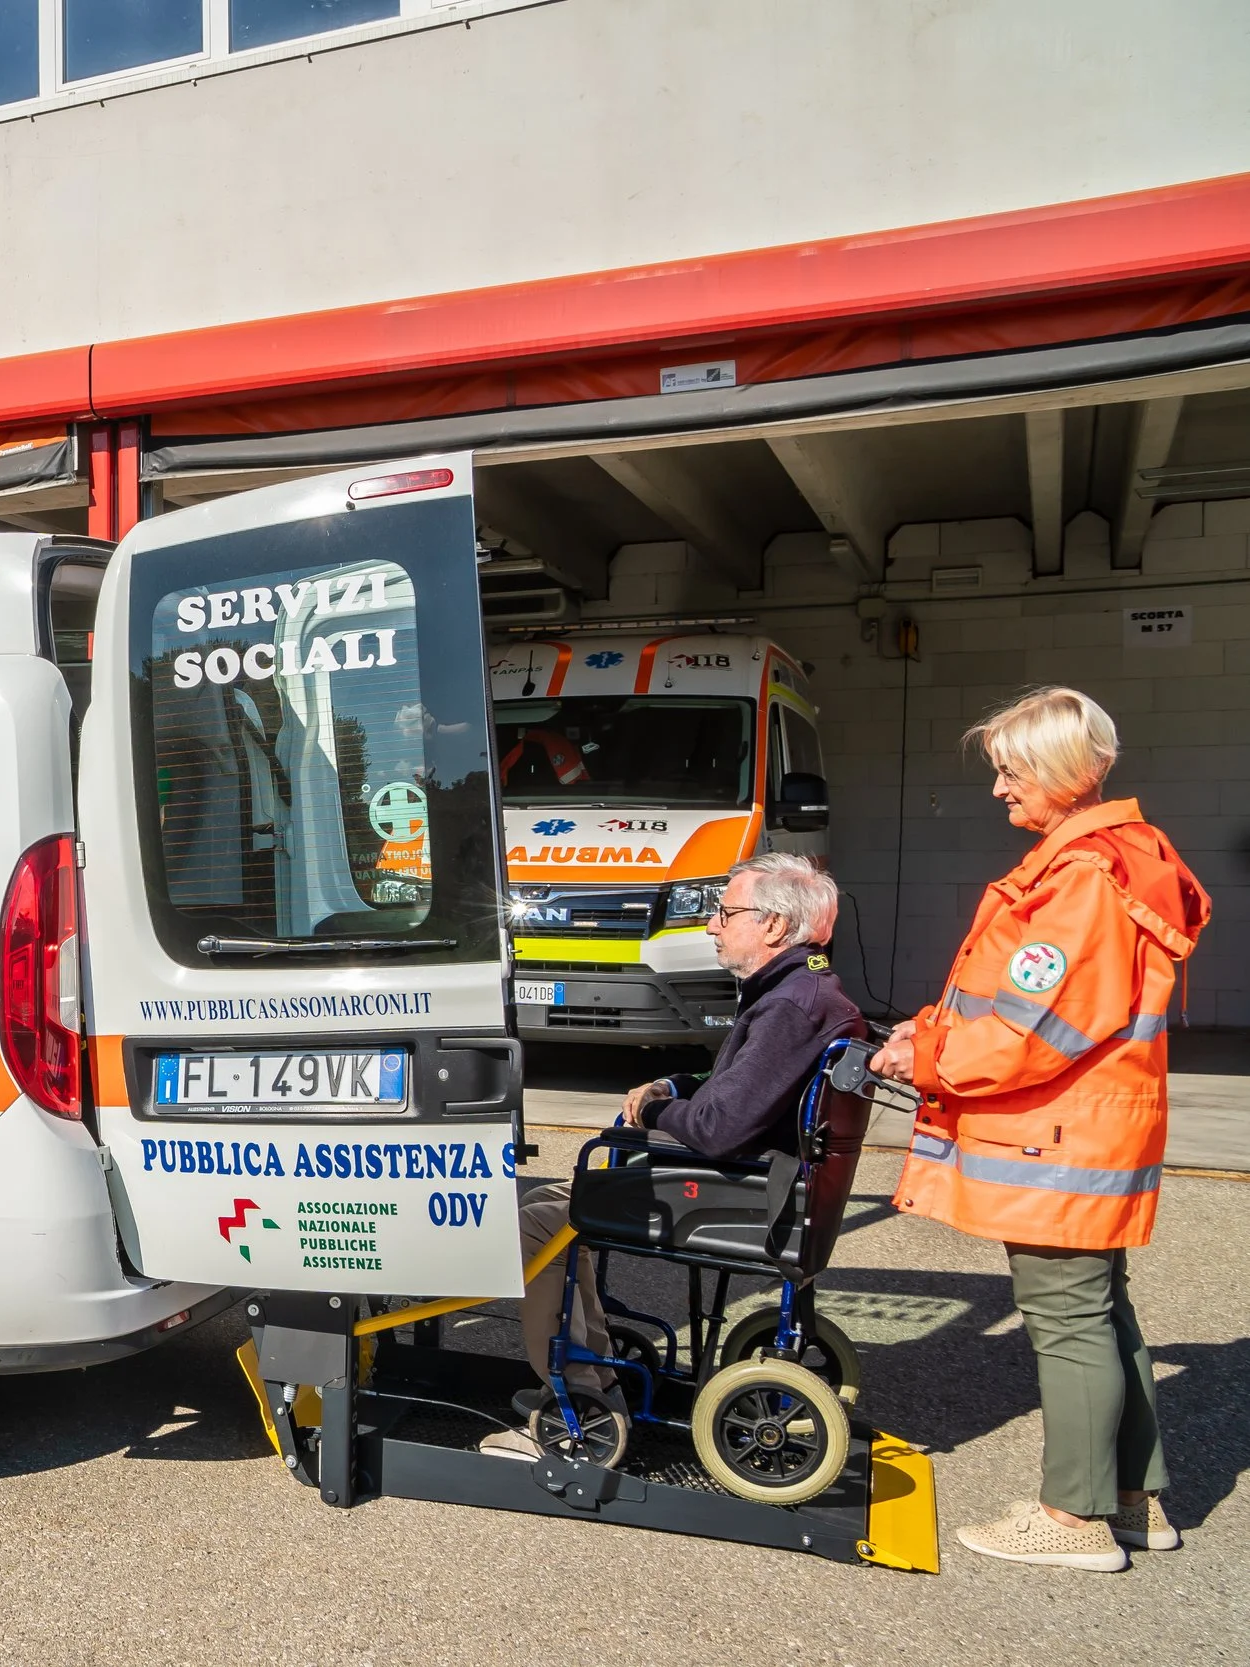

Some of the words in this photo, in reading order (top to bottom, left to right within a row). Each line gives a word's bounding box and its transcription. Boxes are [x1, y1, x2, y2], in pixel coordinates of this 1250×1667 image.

[177, 572, 389, 633] SERVIZI
[1131, 610, 1184, 620] SCORTA
[1141, 624, 1153, 632] M
[1157, 623, 1173, 632] 57
[173, 629, 397, 689] SOCIALI
[693, 654, 731, 668] 118
[626, 820, 668, 832] 118
[513, 907, 568, 922] AN
[139, 992, 432, 1021] WWW.PUBBLICASASSOMARCONI.IT
[183, 1055, 228, 1098] FL
[250, 1053, 374, 1098] 149VK
[222, 1105, 252, 1113] VISION
[140, 1139, 286, 1177] PUBBLICA
[293, 1142, 493, 1180] ASSISTENZA
[684, 1181, 699, 1199] 3
[297, 1201, 398, 1216] ASSOCIAZIONE
[428, 1191, 488, 1228] ODV
[297, 1219, 377, 1234] NAZIONALE
[299, 1237, 377, 1252] PUBBLICHE
[302, 1255, 383, 1270] ASSISTENZE
